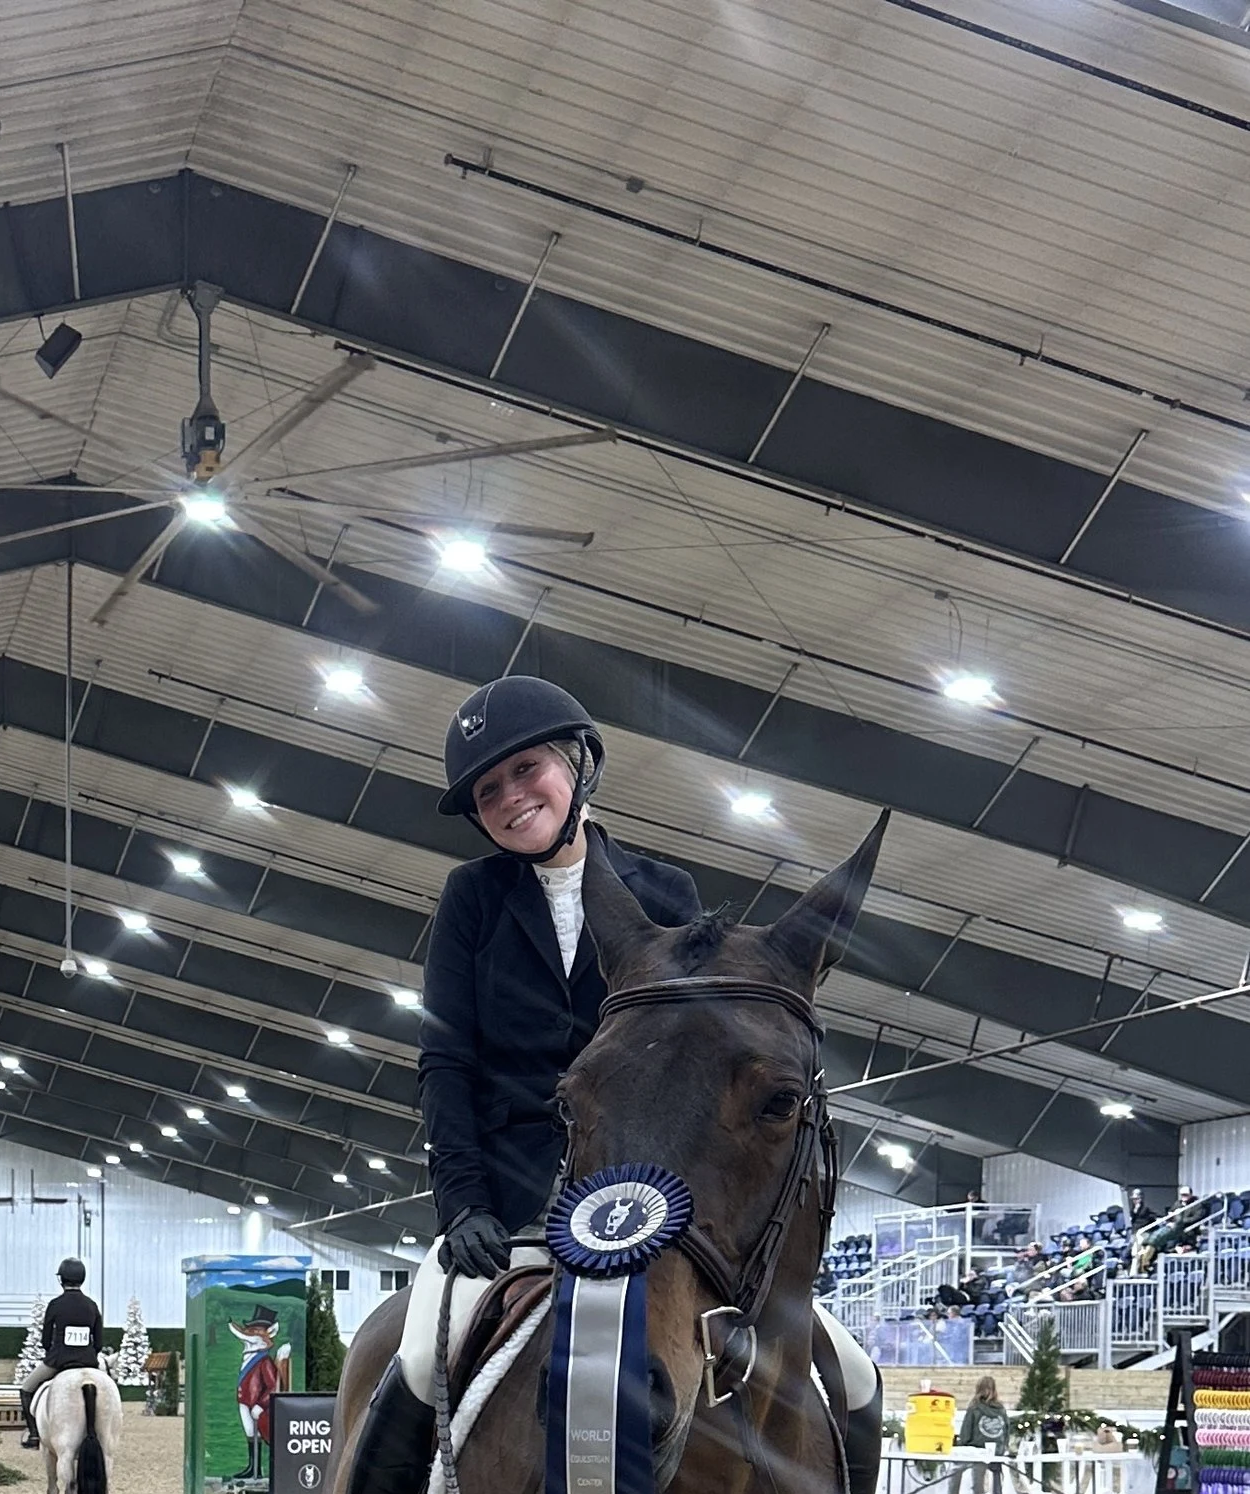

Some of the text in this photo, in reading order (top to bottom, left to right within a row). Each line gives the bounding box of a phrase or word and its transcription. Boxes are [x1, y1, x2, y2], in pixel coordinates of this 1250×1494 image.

[67, 1331, 88, 1343] 7114
[289, 1420, 331, 1436] RING
[570, 1429, 611, 1442] WORLD
[287, 1438, 332, 1454] OPEN
[570, 1454, 610, 1464] EQUESTRIAN
